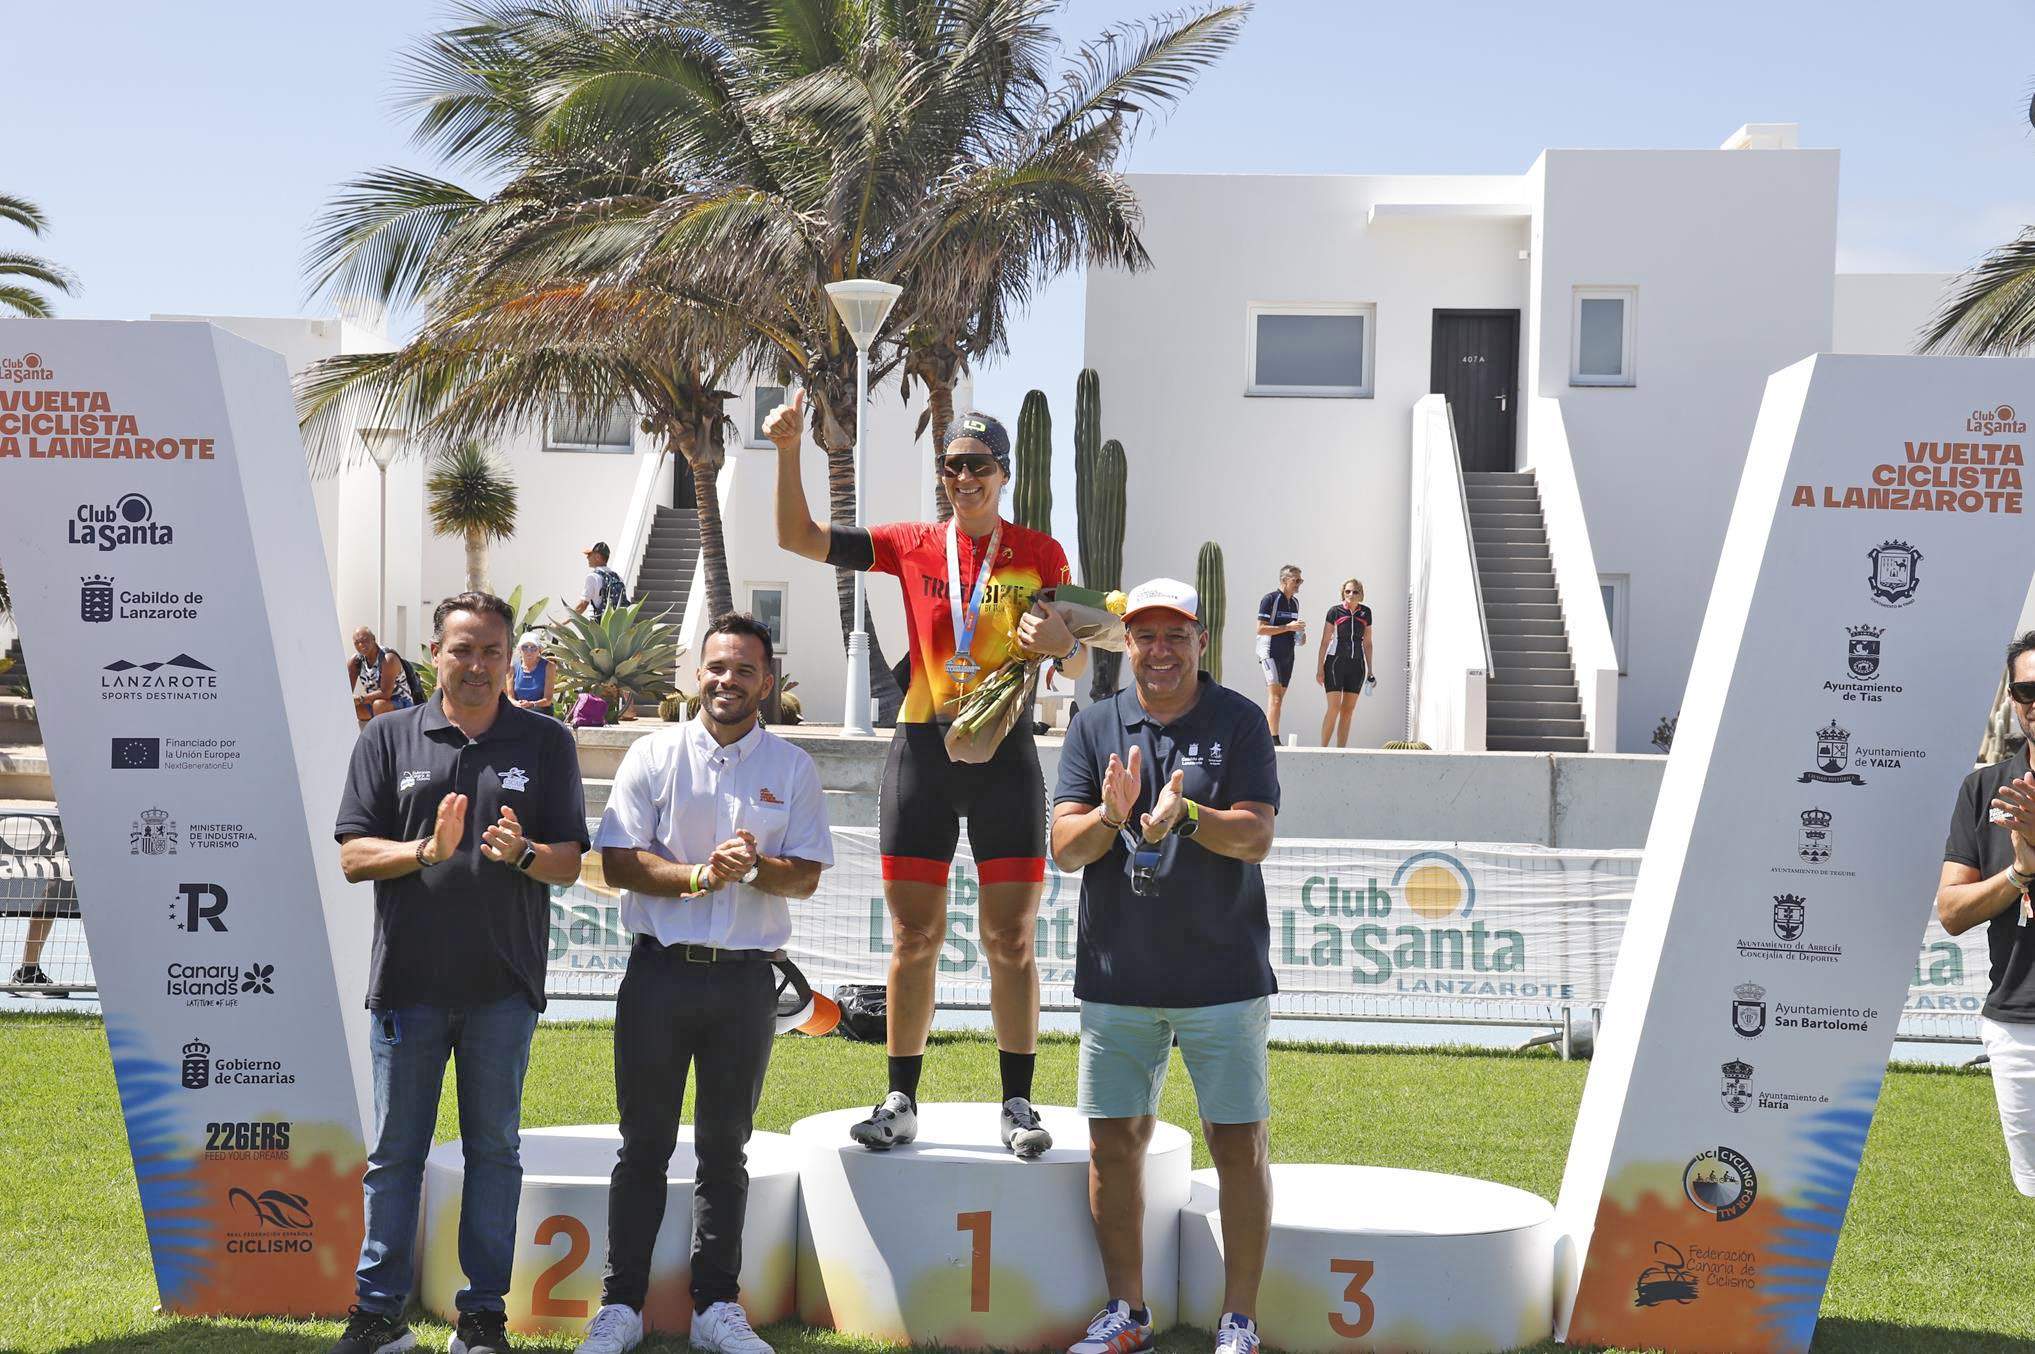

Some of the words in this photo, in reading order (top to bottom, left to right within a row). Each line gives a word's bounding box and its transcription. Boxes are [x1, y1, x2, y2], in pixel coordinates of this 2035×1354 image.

[2, 358, 24, 368] Club
[0, 390, 111, 412] VUELTA
[1972, 411, 1995, 421] Club
[0, 413, 139, 436] CICLISTA
[0, 437, 21, 457] A
[29, 438, 215, 460] LANZAROTE
[1904, 441, 2024, 466] VUELTA
[1872, 464, 2023, 490] CICLISTA
[1791, 486, 1816, 508] A
[1823, 487, 2023, 514] LANZAROTE
[77, 504, 117, 523] Club
[120, 591, 179, 604] Cabildo
[184, 591, 203, 604] de
[120, 606, 197, 619] Lanzarote
[102, 676, 217, 688] LANZAROTE
[1823, 680, 1903, 692] Ayuntamiento
[102, 692, 142, 700] SPORTS
[146, 692, 218, 700] DESTINATION
[1842, 692, 1856, 701] de
[165, 738, 217, 748] Financiado
[220, 740, 236, 751] por
[204, 752, 240, 761] Europea
[1855, 747, 1926, 760] Ayuntamiento
[164, 761, 233, 769] NextGenerationEU
[1855, 758, 1867, 767] de
[1870, 758, 1901, 768] YAIZA
[190, 824, 243, 832] MINISTERIO
[205, 833, 257, 841] INDUSTRIA,
[1301, 876, 1392, 918] Club
[168, 963, 239, 982] Canary
[167, 980, 238, 995] Islands
[1396, 978, 1574, 1000] LANZAROTE
[1775, 1003, 1860, 1018] Ayuntamiento
[1863, 1008, 1878, 1019] de
[1775, 1016, 1798, 1028] San
[1801, 1018, 1868, 1032] Bartolomé
[215, 1059, 281, 1070] Gobierno
[215, 1072, 231, 1084] de
[234, 1072, 295, 1084] Canarias
[1759, 1091, 1816, 1103] Ayuntamiento
[1818, 1094, 1829, 1103] de
[1758, 1099, 1789, 1110] Haría
[205, 1122, 290, 1150] 226ERS
[205, 1152, 226, 1160] FEED
[228, 1152, 250, 1160] YOUR
[253, 1151, 289, 1160] DREAMS
[1696, 1150, 1717, 1161] UCI
[1721, 1150, 1754, 1187] CYCLING
[1736, 1189, 1753, 1209] FOR
[227, 1240, 313, 1253] CICLISMO
[531, 1214, 591, 1318] 2
[957, 1210, 992, 1313] 1
[1687, 1258, 1733, 1274] Canaria
[1741, 1262, 1755, 1275] de
[1707, 1273, 1755, 1288] Ciclismo
[1328, 1258, 1375, 1338] 3
